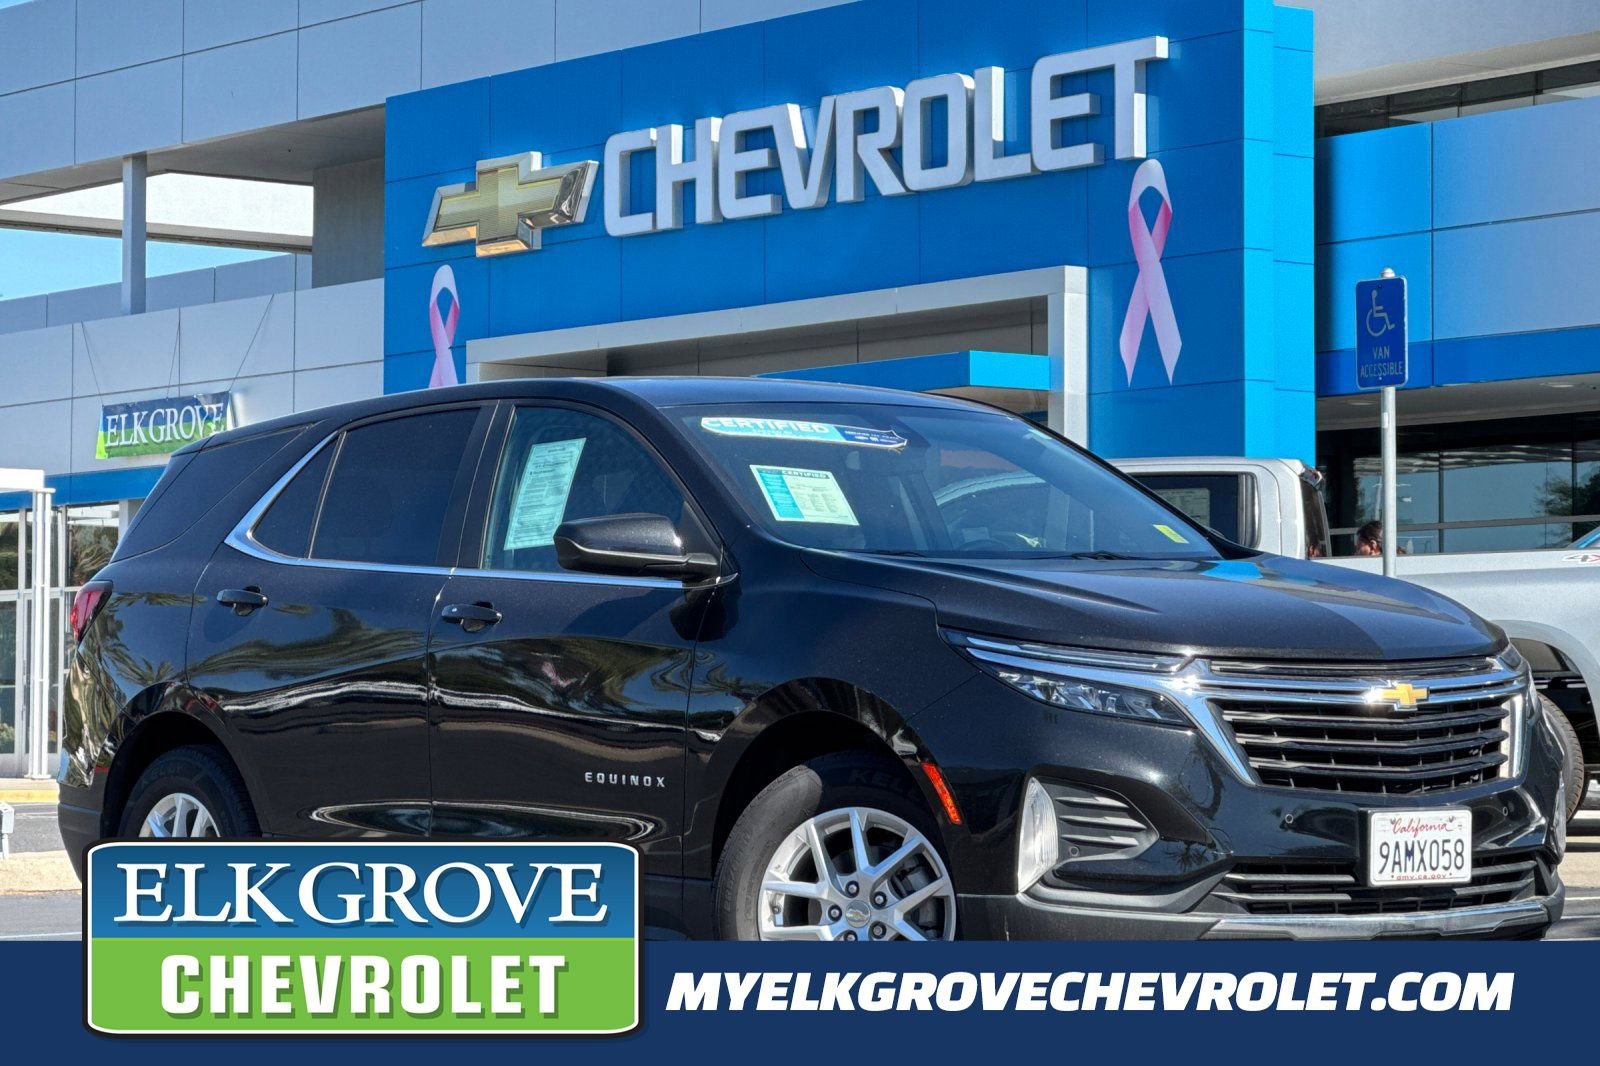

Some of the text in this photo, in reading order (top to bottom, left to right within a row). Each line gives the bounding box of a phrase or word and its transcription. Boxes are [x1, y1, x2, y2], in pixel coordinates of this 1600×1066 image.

[604, 36, 1168, 237] CHEVROLET
[1372, 345, 1390, 359] VAN
[1360, 361, 1403, 378] ACCESSIBLE
[105, 402, 224, 447] ELK GROVE
[702, 418, 829, 434] CERTIFIED
[584, 771, 665, 788] EQUINOX
[1391, 818, 1455, 838] California
[1378, 838, 1465, 875] 9AMX058
